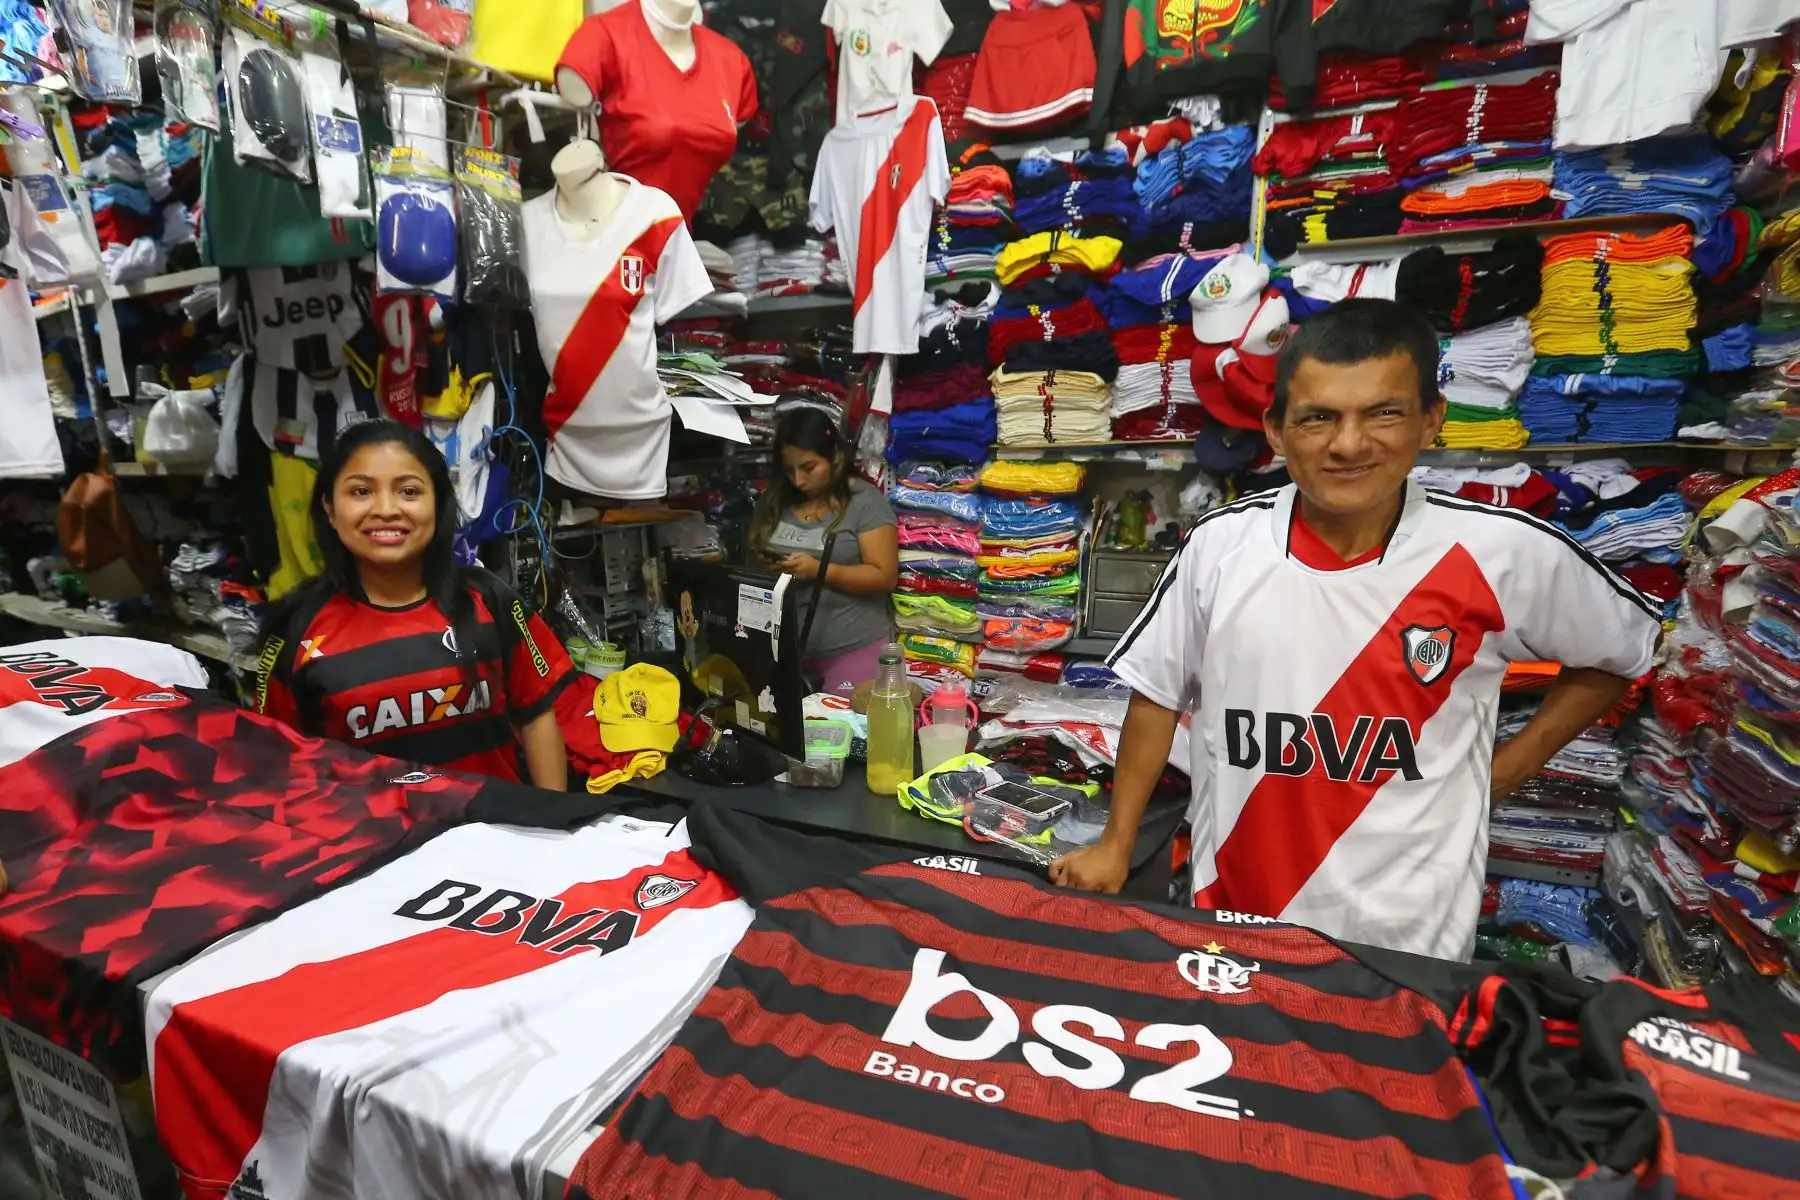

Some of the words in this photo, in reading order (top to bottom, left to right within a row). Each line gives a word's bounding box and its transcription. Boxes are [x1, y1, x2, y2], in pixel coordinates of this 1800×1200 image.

[262, 294, 344, 328] Jeep
[384, 298, 412, 373] 9
[1225, 708, 1424, 782] BBVA
[392, 878, 640, 958] BBVA
[863, 1050, 1006, 1103] Banco
